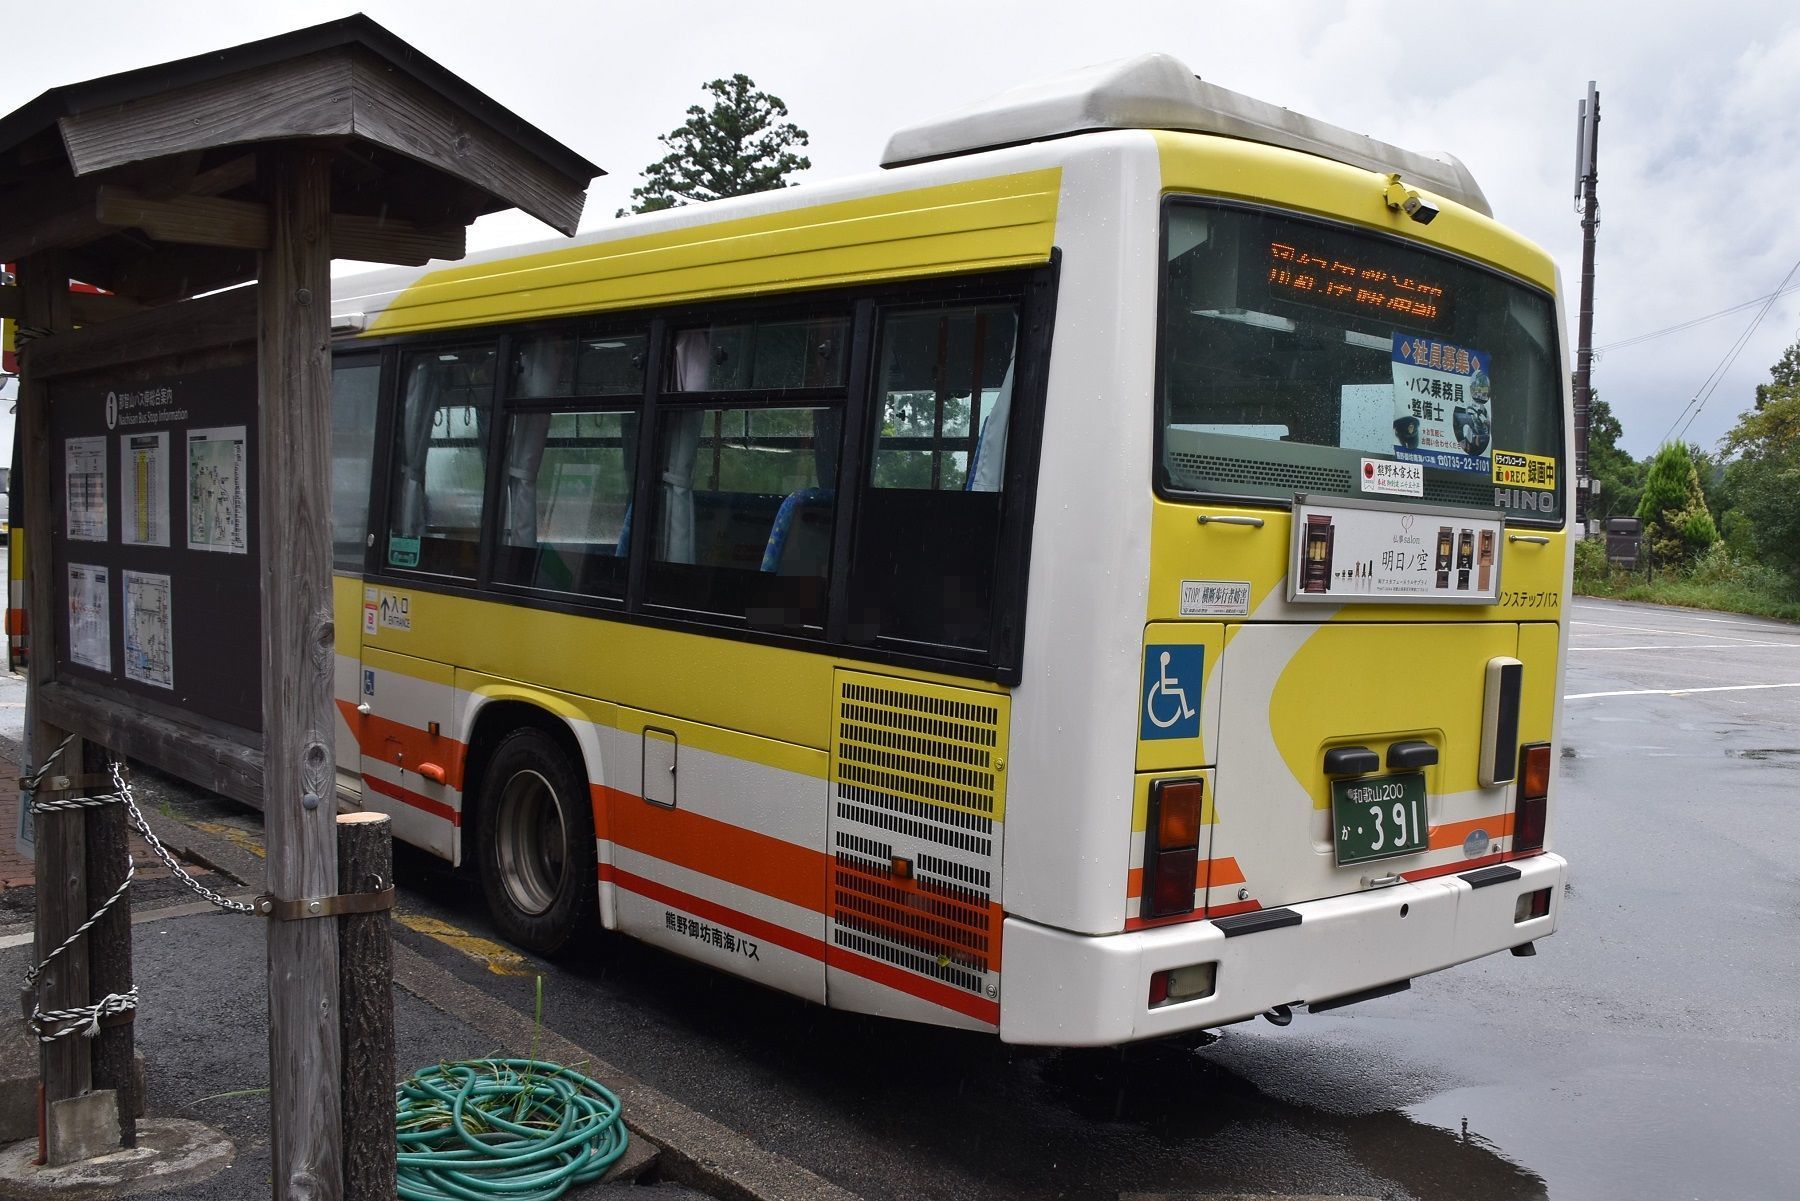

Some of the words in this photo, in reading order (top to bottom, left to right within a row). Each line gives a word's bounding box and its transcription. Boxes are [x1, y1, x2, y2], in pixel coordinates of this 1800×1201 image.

[1412, 339, 1470, 375] 社員募集
[1411, 377, 1465, 404] バス乗務員
[1411, 398, 1445, 422] 整備士
[1377, 463, 1421, 480] 熊野本宮大社
[1510, 470, 1526, 484] REC
[1528, 459, 1554, 486] 録画中
[1494, 487, 1554, 513] HINO
[391, 595, 409, 614] 入口
[388, 615, 411, 629] ENTRANCE
[1353, 783, 1404, 804] 和歌山200
[1341, 825, 1351, 841] か
[665, 911, 760, 961] 熊野御坊南海バス
